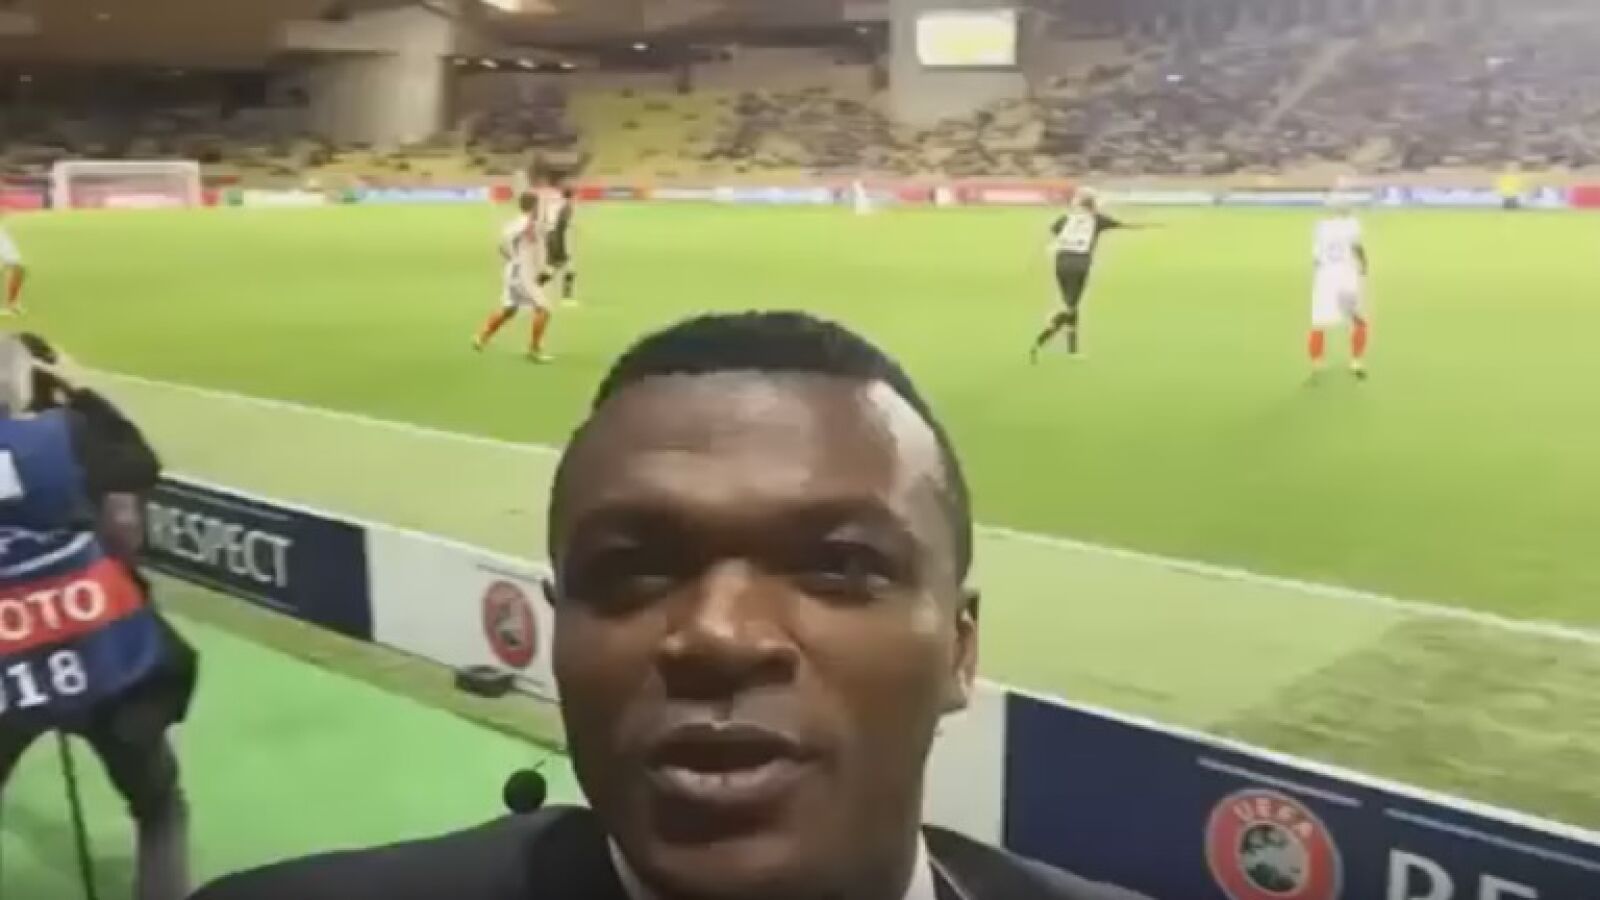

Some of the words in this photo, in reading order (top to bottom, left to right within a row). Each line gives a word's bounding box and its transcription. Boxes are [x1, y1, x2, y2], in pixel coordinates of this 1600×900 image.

[147, 502, 294, 588] RESPECT
[0, 580, 105, 640] OTO
[0, 650, 87, 711] 18
[1232, 797, 1313, 839] UEFA
